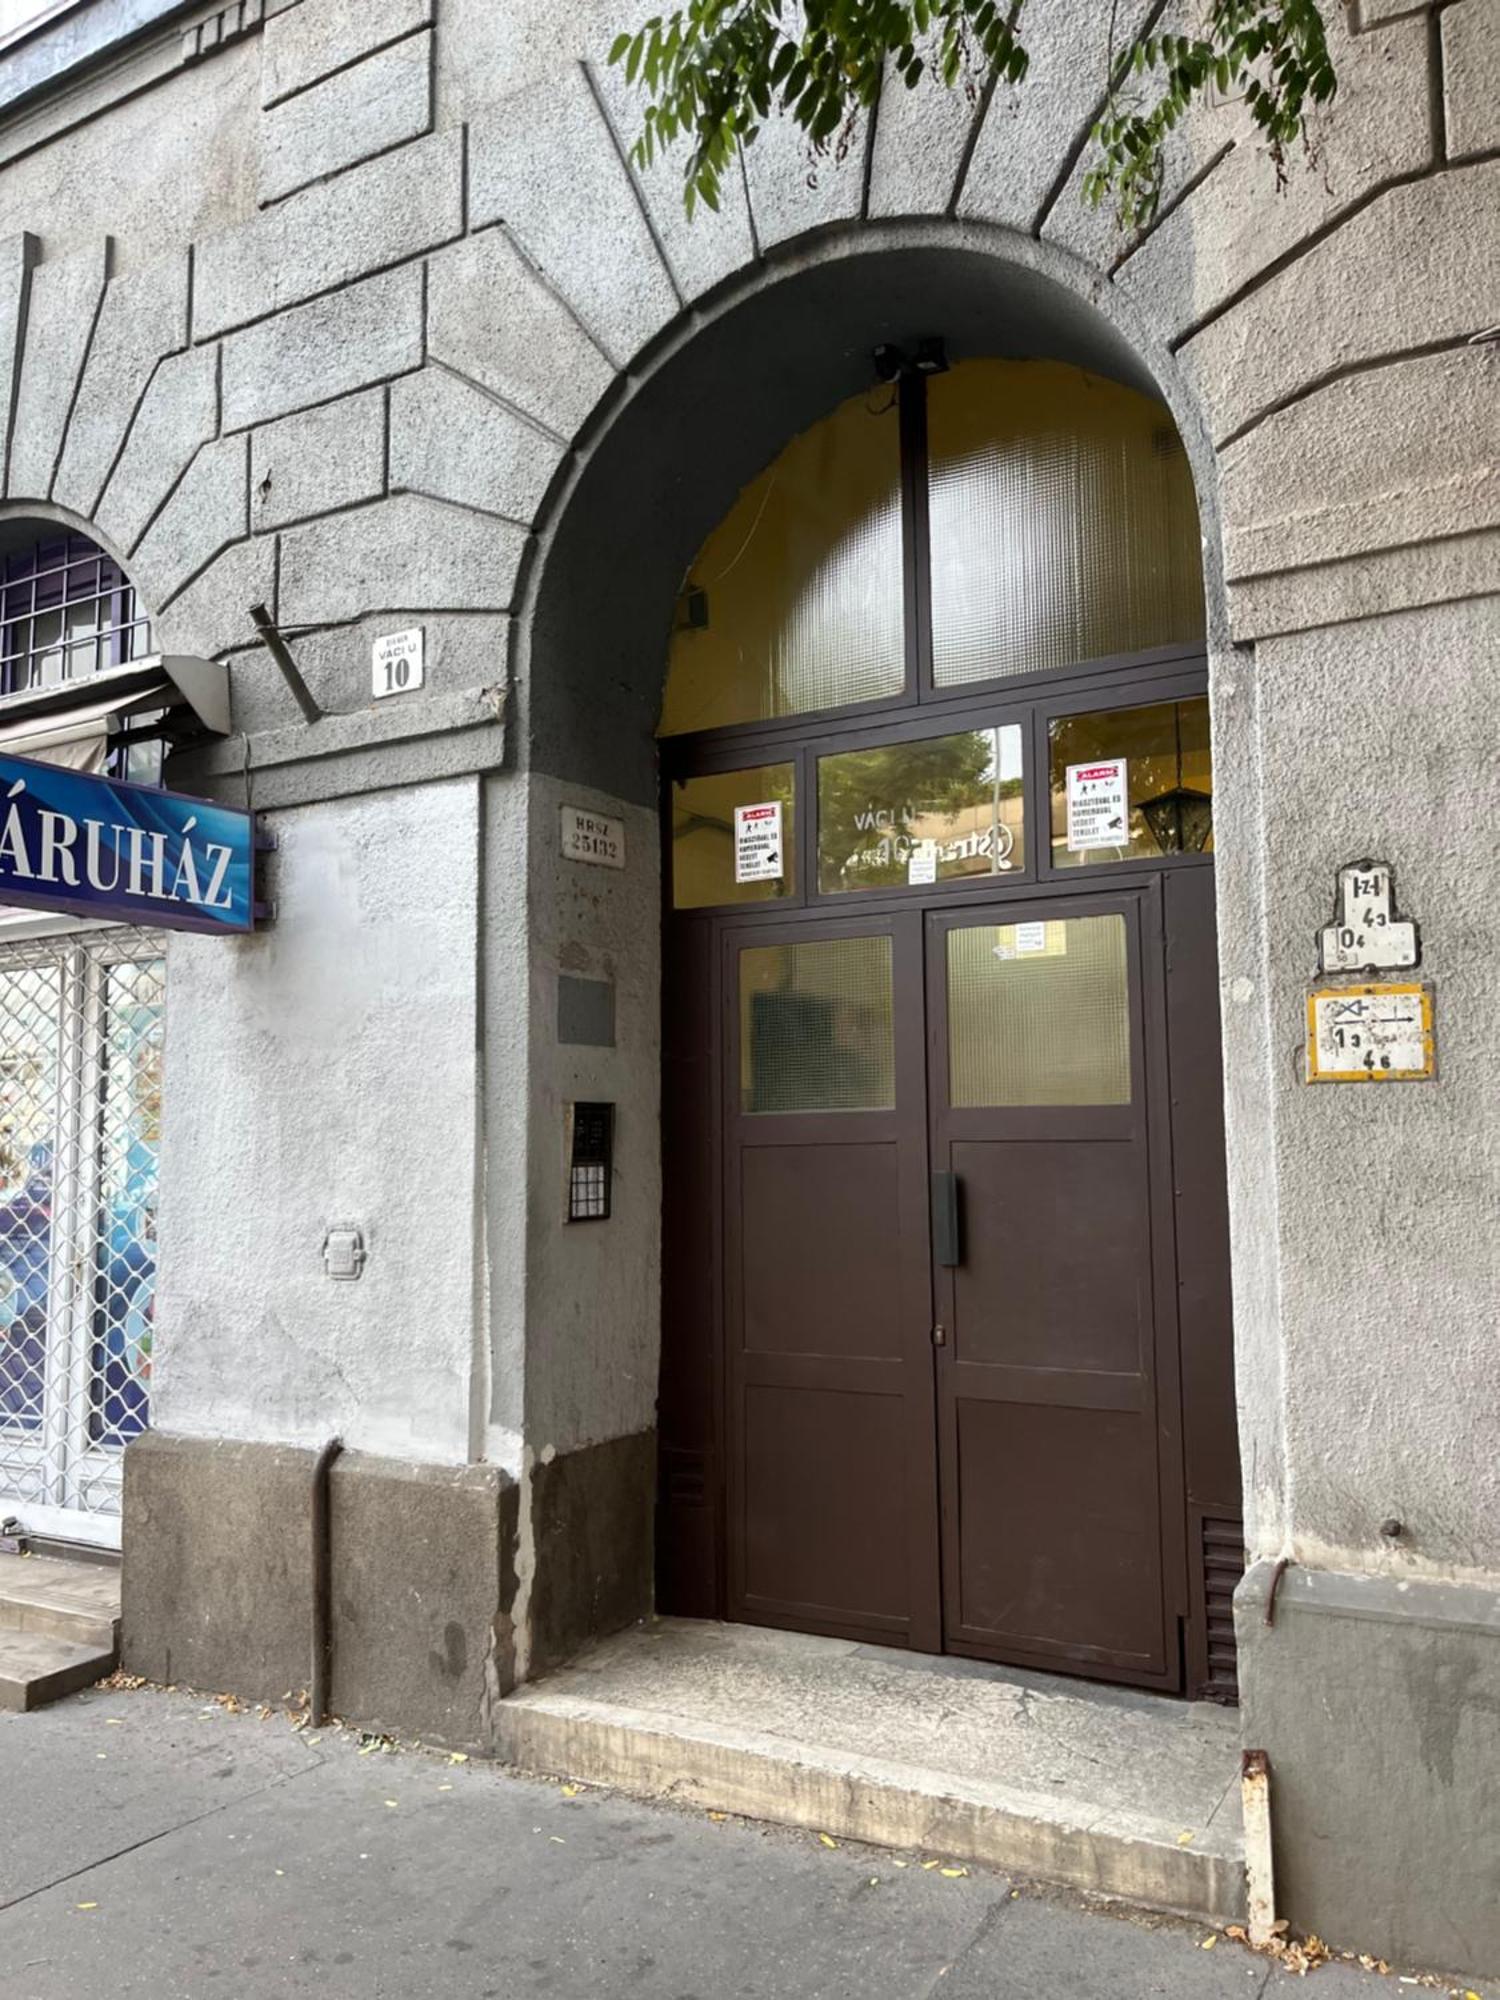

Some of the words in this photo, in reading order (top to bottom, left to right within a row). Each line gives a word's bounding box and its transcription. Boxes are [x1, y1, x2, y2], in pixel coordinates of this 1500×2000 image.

[384, 658, 410, 691] 10
[0, 778, 234, 909] ÁRUHÁZ
[1334, 1028, 1361, 1048] 13
[1363, 1049, 1391, 1071] 46
